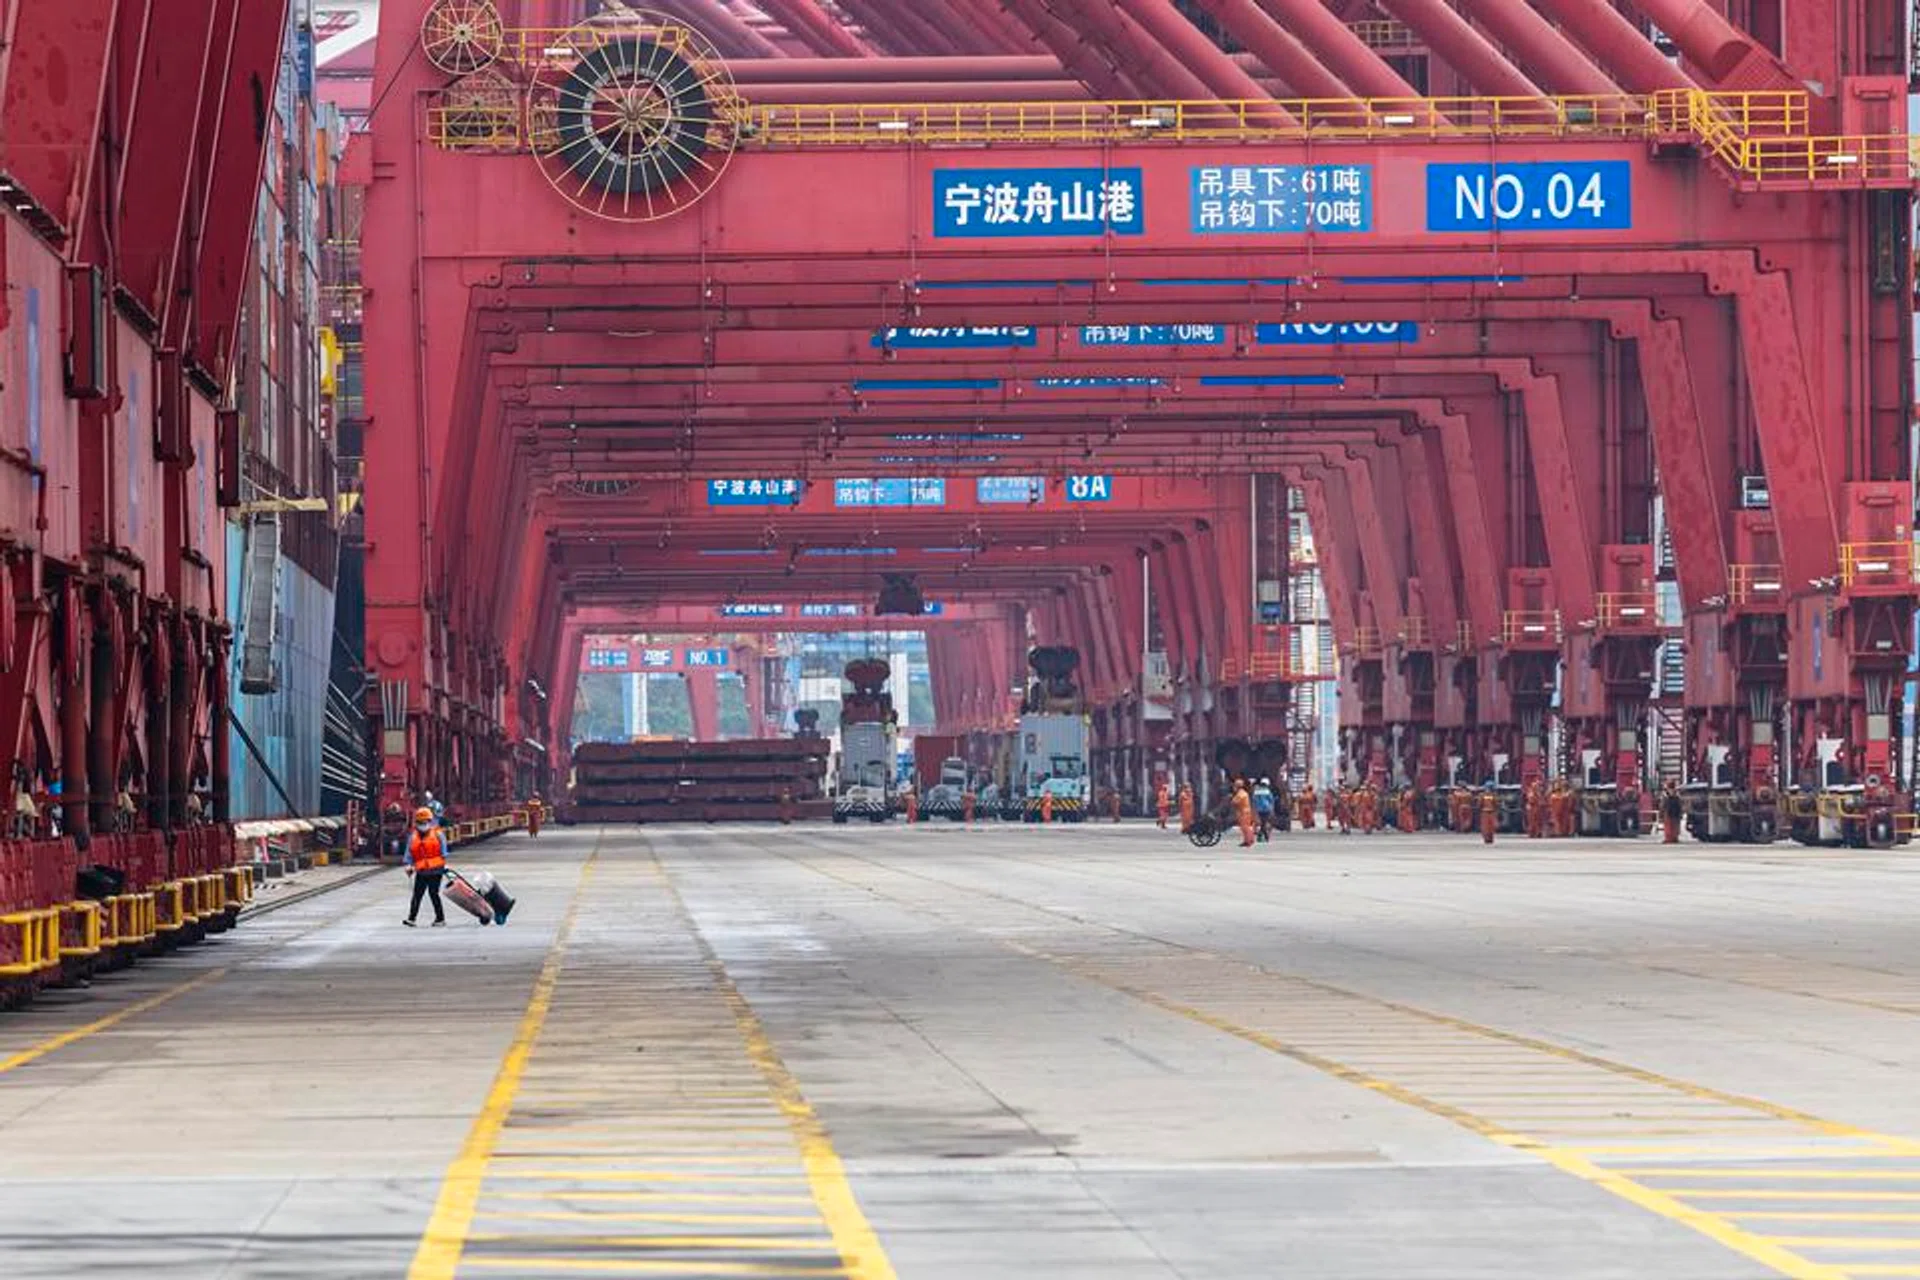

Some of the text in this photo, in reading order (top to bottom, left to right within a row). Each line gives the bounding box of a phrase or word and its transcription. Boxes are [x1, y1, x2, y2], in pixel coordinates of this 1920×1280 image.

[1199, 167, 1361, 197] 吊具下:61吨
[1454, 172, 1606, 220] NO.04
[944, 181, 1135, 226] 宁波舟山港
[1199, 198, 1361, 229] 吊钩下:70吨
[1071, 475, 1107, 498] 8A
